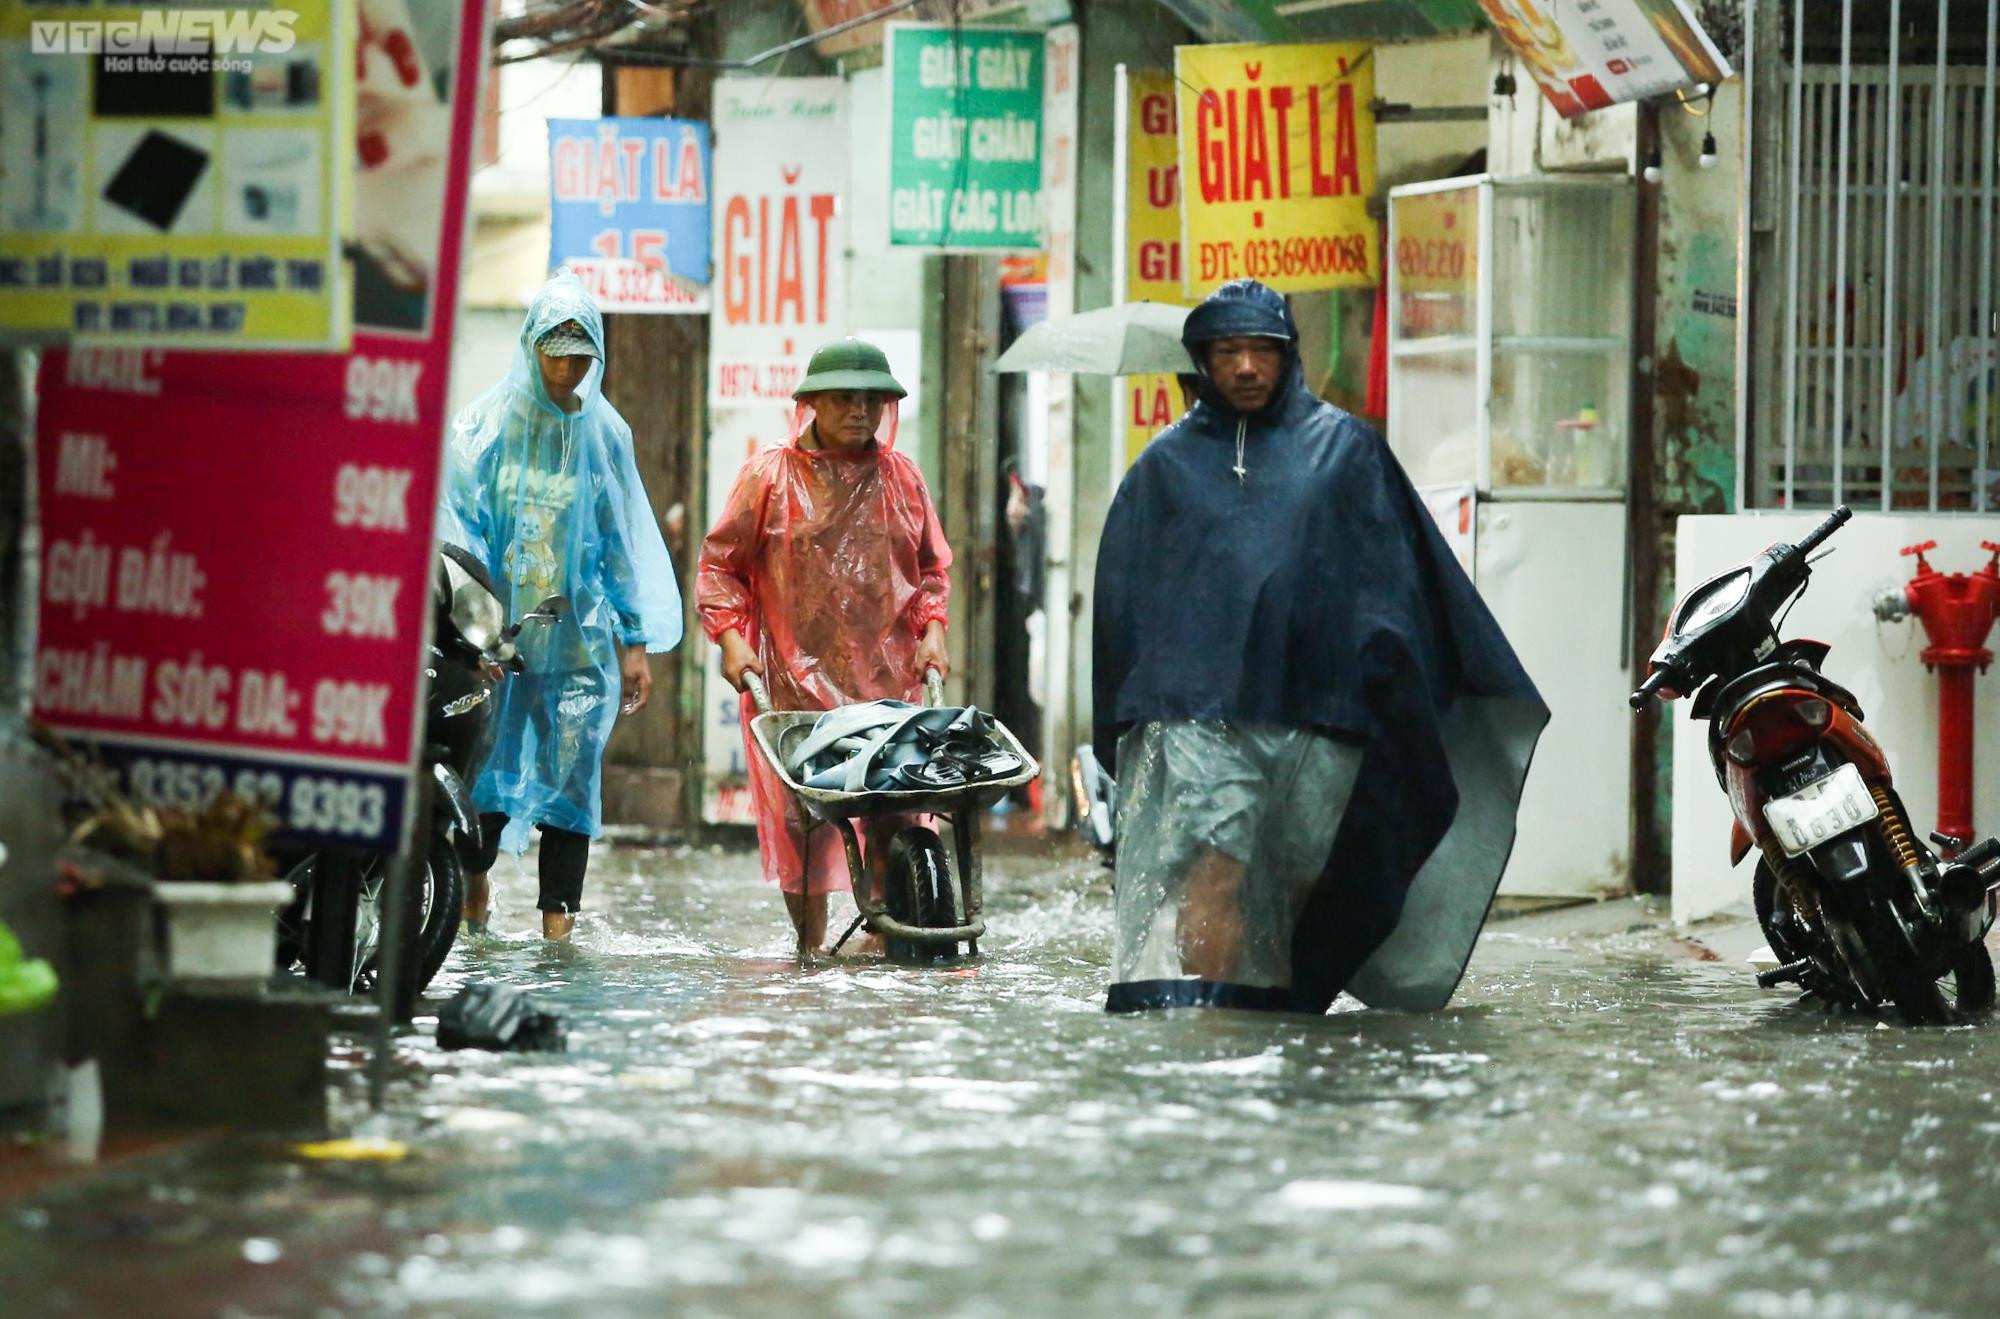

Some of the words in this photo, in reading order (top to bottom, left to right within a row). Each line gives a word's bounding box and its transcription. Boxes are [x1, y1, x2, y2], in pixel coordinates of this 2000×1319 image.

[919, 40, 973, 97] GIẶT
[976, 38, 1032, 90] GIÀY
[555, 121, 646, 216] GIẶT
[652, 124, 707, 204] LÀ
[912, 109, 967, 169] GIẶT
[1197, 62, 1293, 228] GIẶT
[1308, 56, 1361, 198] LÀ
[893, 181, 947, 240] GIẶT
[950, 180, 999, 233] CÁC
[724, 165, 836, 356] GIẶT
[1200, 242, 1239, 281] ĐT:
[1245, 234, 1367, 278] 0336900068
[344, 355, 423, 425] 99K
[1133, 378, 1172, 428] LÀ
[332, 461, 413, 532] 99K
[321, 569, 401, 640] 39K
[153, 650, 232, 728] SÓC
[236, 667, 298, 738] DA:
[311, 678, 390, 748] 99K
[288, 776, 388, 839] 9393
